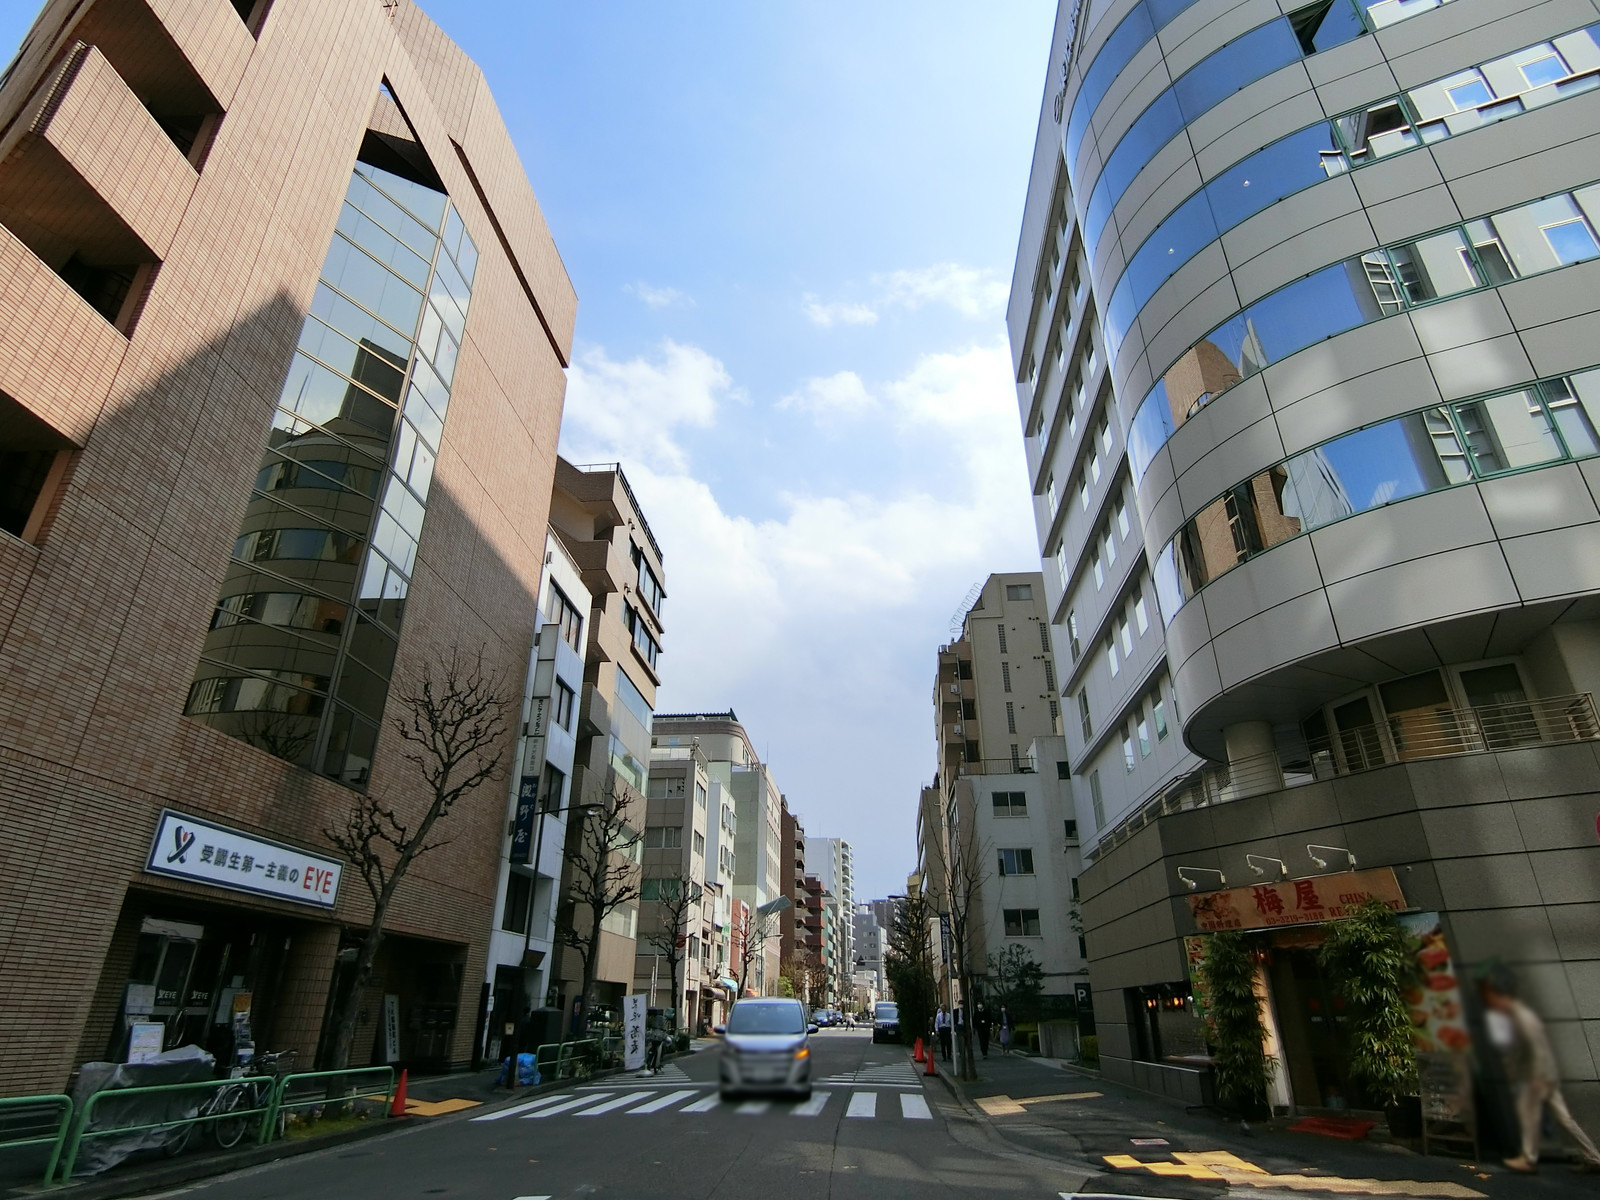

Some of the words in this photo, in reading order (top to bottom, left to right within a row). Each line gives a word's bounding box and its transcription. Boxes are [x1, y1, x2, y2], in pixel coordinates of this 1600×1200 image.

[199, 844, 299, 884] 受講生第一主義の
[303, 866, 334, 894] EYE
[1252, 880, 1324, 915] 梅屋
[1339, 892, 1373, 905] CHINA
[1077, 989, 1086, 1002] P
